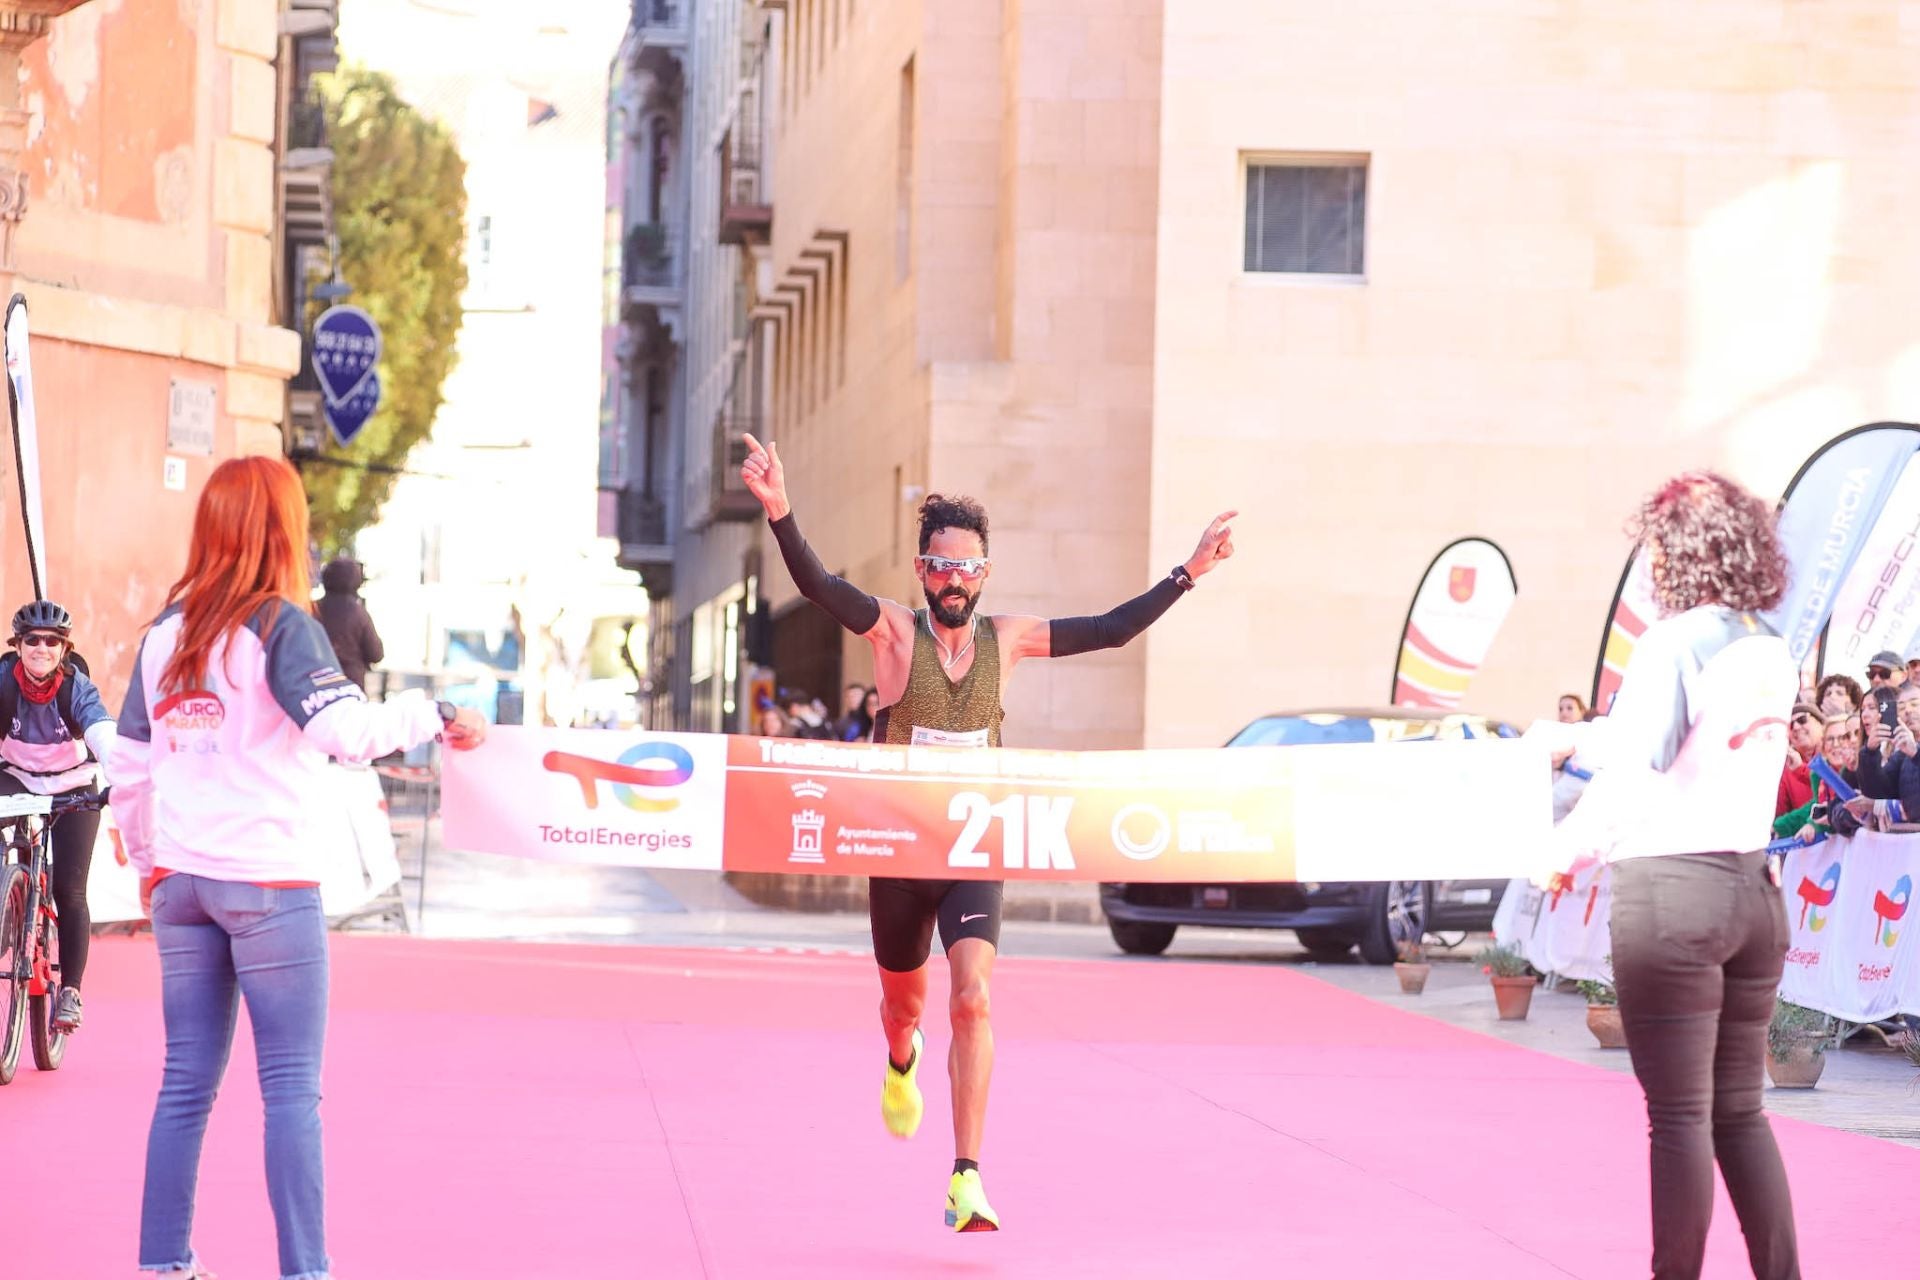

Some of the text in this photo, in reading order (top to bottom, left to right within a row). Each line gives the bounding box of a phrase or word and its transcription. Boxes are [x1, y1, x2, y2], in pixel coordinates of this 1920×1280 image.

[1807, 574, 1832, 610] DE
[1821, 466, 1871, 571] MURCIA
[1846, 512, 1920, 659] PORSCH
[539, 825, 692, 852] TotalEnergies
[836, 825, 917, 841] Ayuntamiento
[836, 842, 895, 857] de Murcia
[947, 791, 1077, 871] 21K
